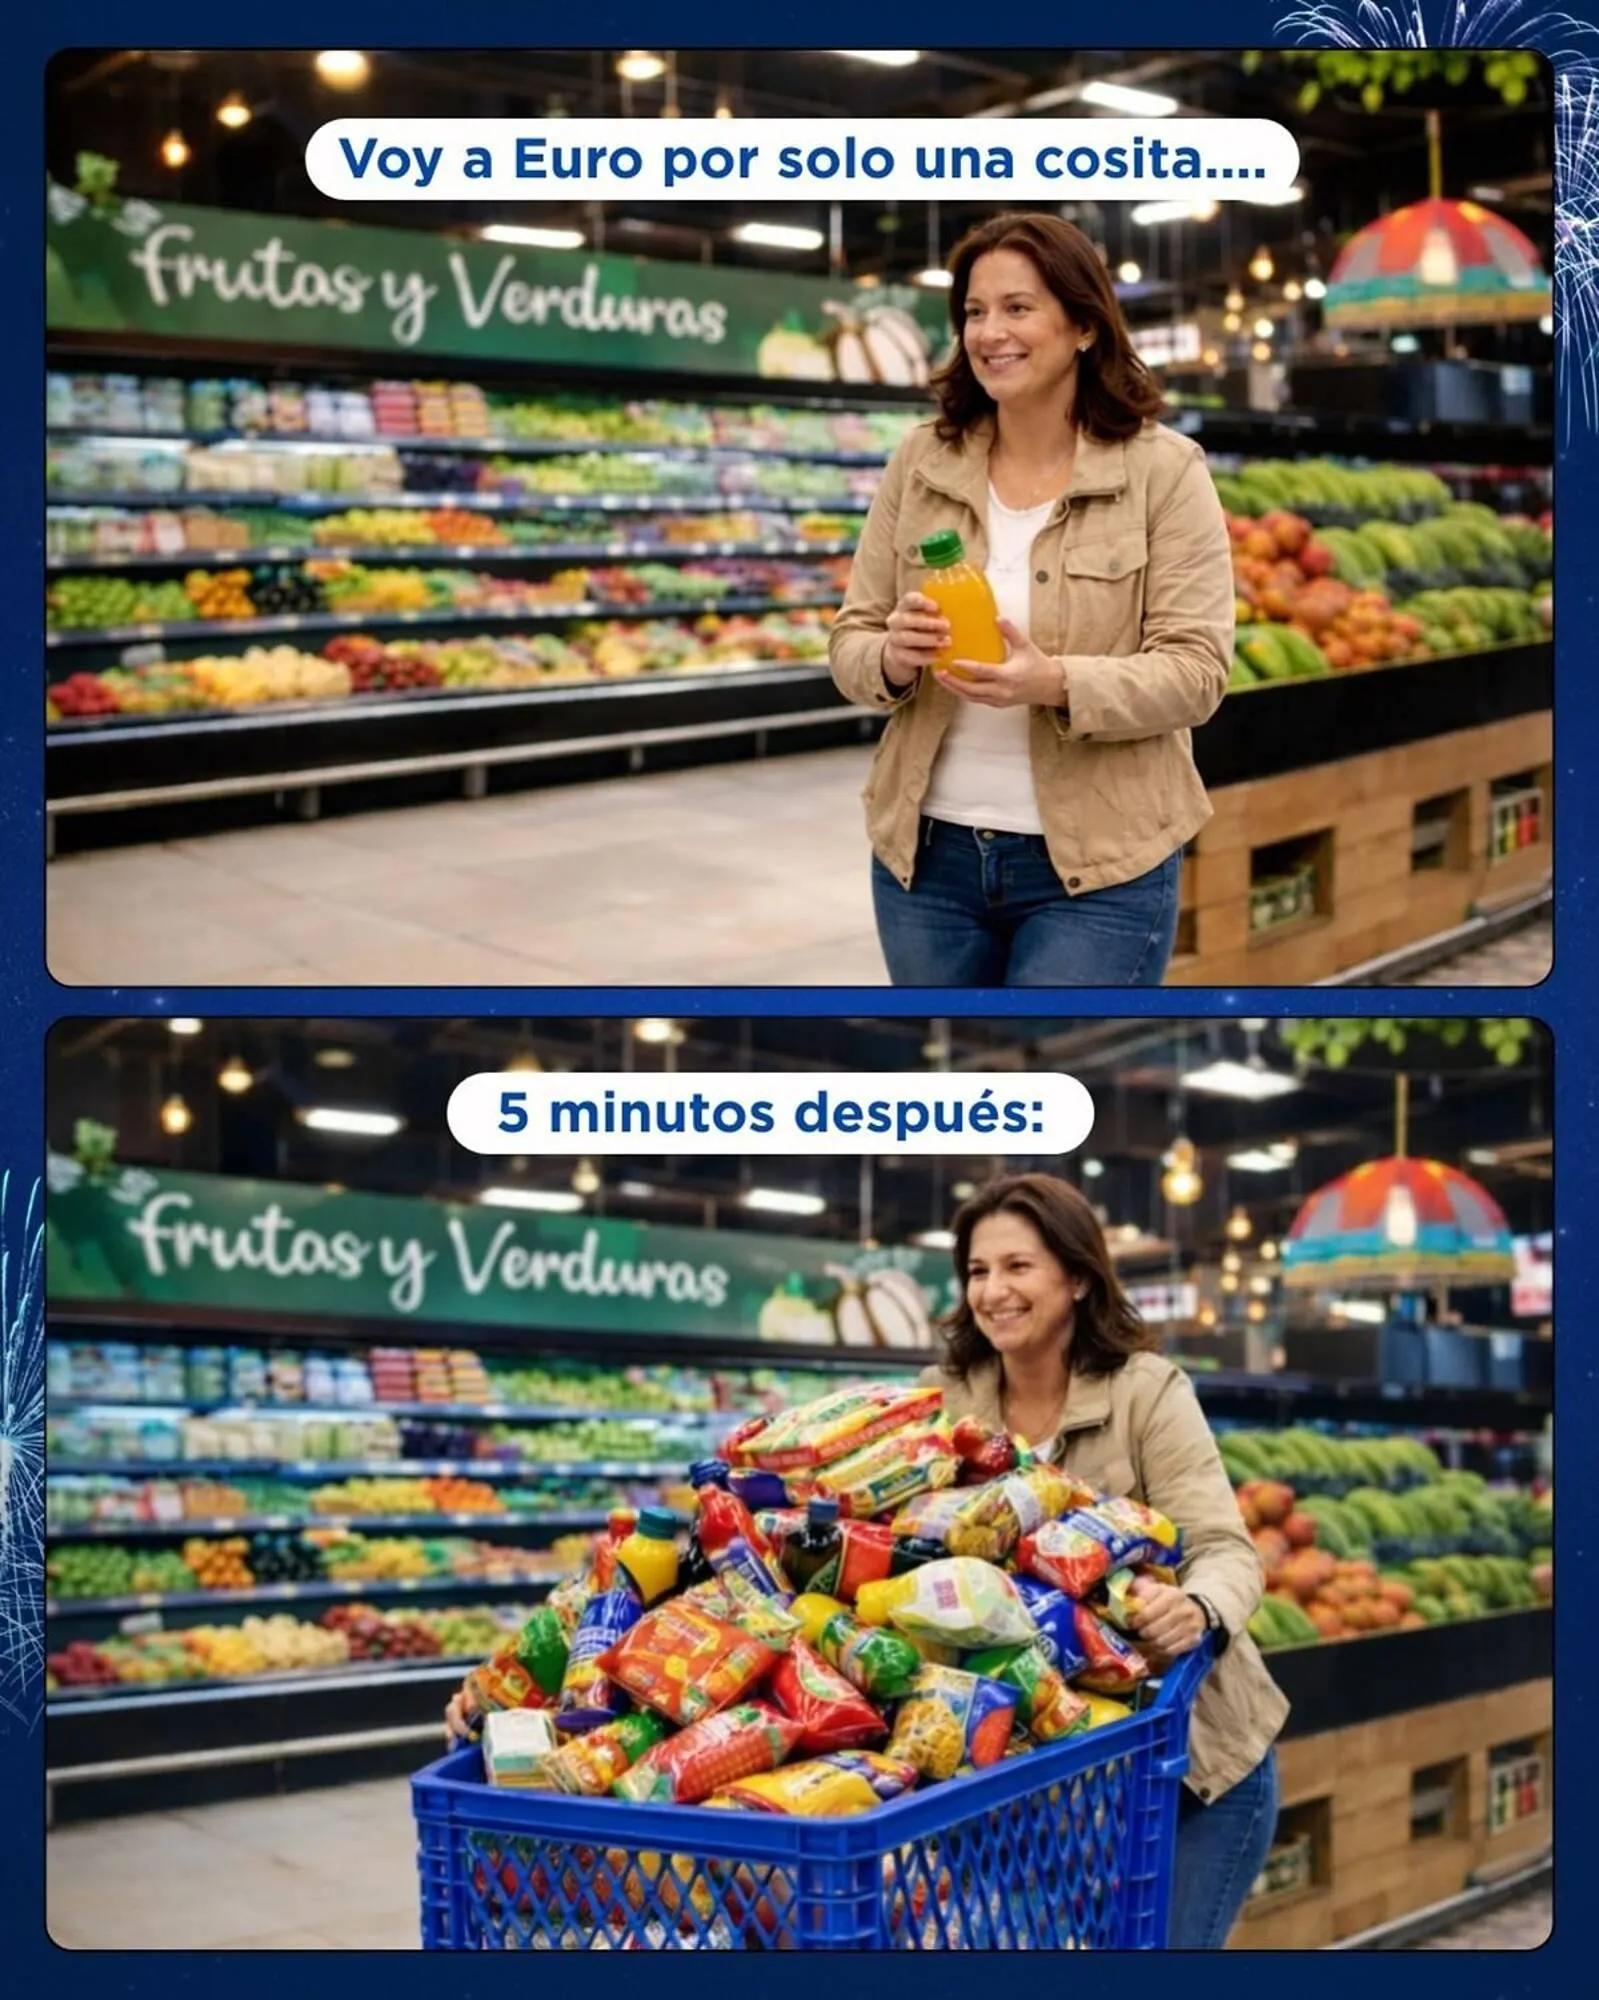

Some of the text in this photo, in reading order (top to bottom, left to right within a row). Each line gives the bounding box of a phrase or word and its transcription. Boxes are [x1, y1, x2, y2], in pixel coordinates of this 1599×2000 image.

[380, 269, 438, 347] y
[448, 251, 728, 345] Verduras
[379, 1237, 437, 1313] y
[447, 1217, 729, 1308] Verduras
